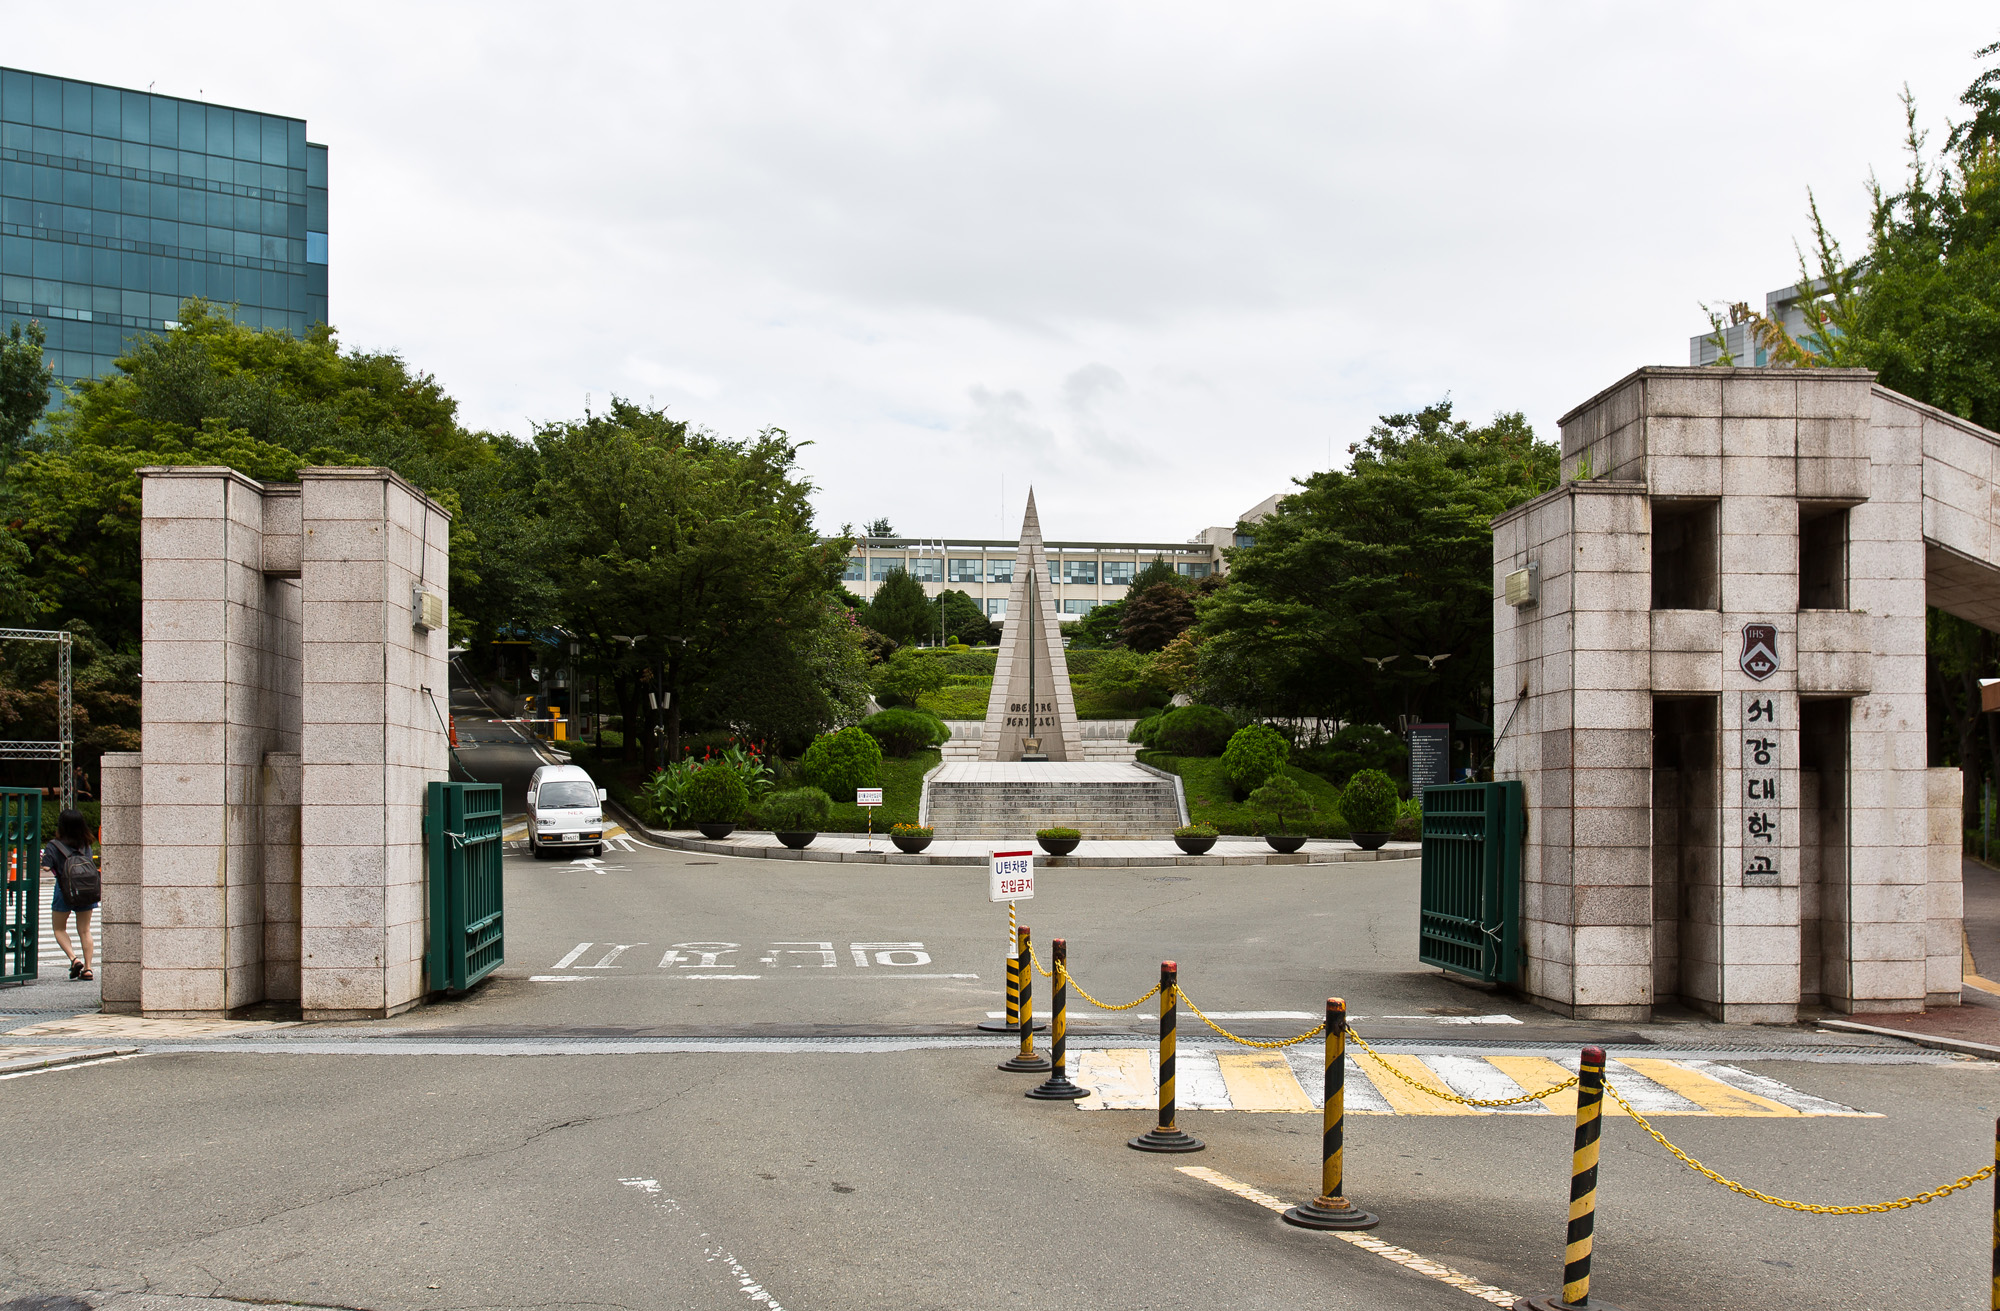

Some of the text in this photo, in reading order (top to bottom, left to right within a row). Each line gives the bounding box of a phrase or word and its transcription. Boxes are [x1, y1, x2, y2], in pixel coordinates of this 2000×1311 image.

[1748, 629, 1764, 639] IHS
[1745, 699, 1778, 875] 서강대학교
[995, 860, 1028, 875] U턴차량
[1000, 878, 1033, 893] 진입금지
